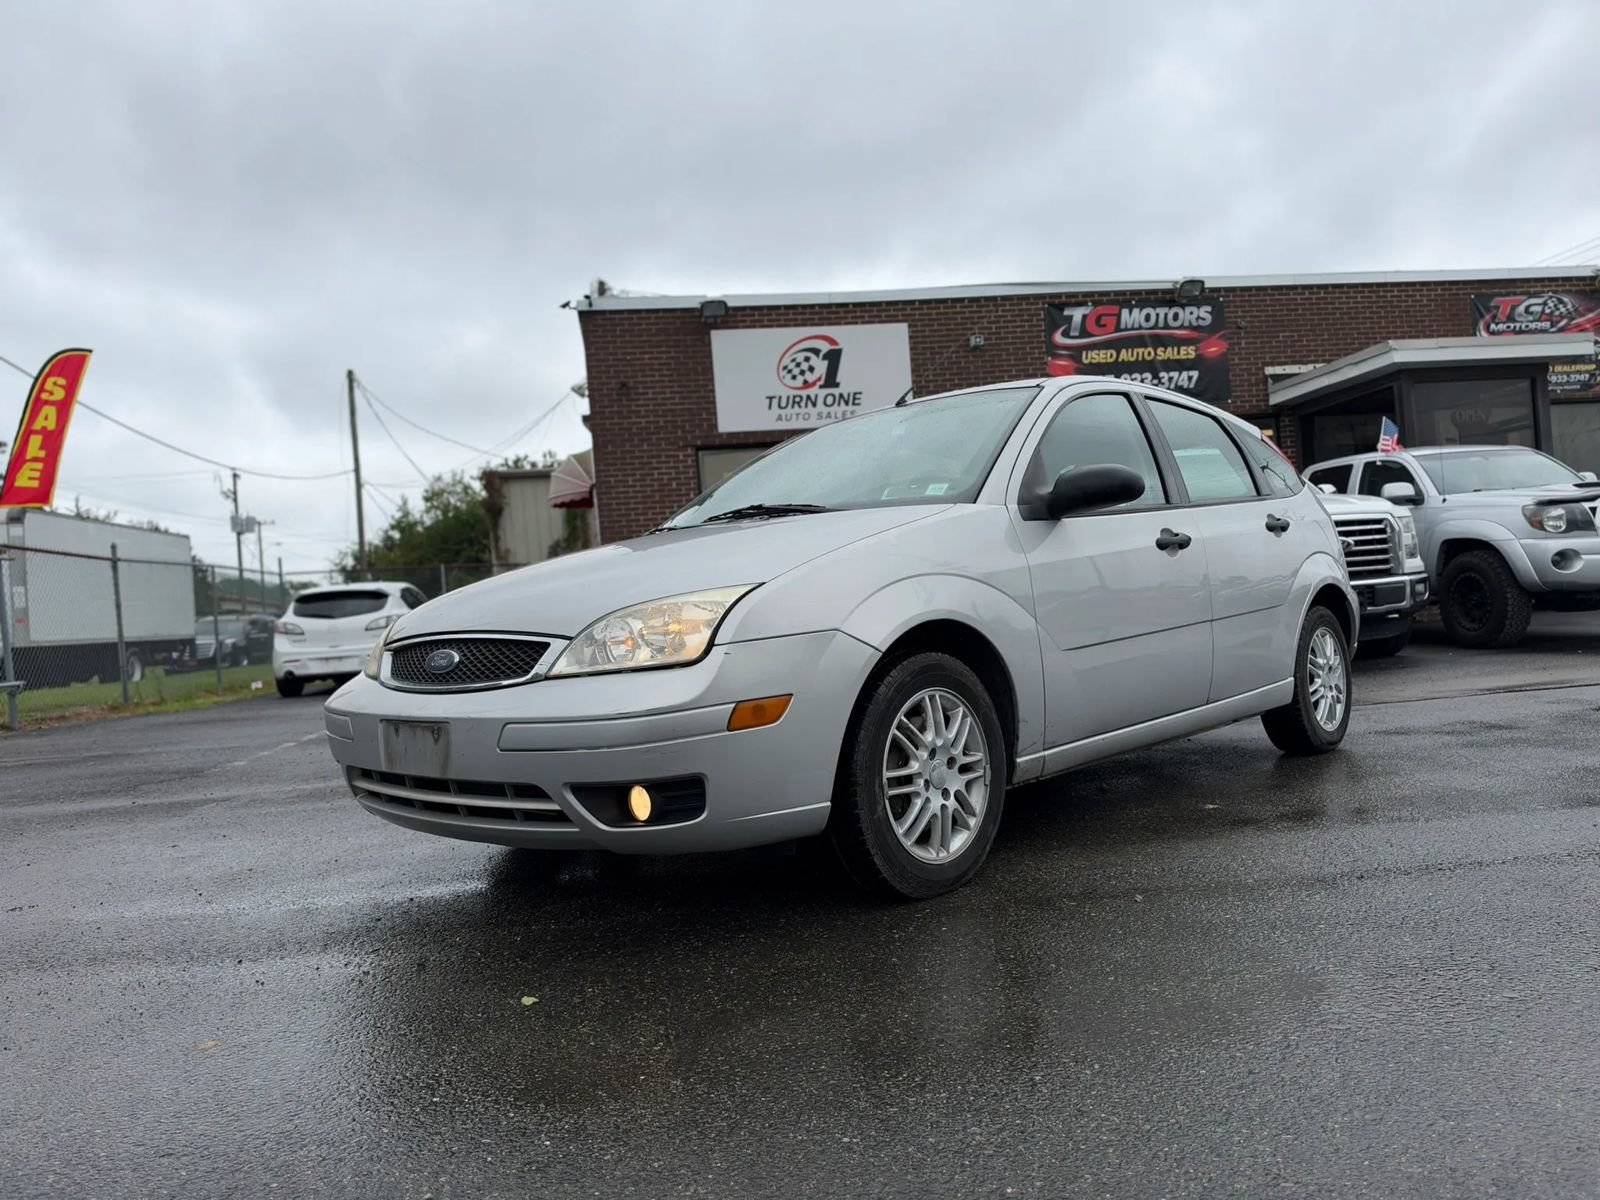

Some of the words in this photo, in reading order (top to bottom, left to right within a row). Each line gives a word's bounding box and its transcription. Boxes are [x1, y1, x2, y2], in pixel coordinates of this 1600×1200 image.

[1490, 294, 1549, 322] TG
[1063, 305, 1120, 336] TG
[1120, 305, 1212, 329] MOTORS
[1489, 321, 1551, 332] MOTORS
[1082, 348, 1117, 364] USED
[1118, 347, 1154, 362] AUTO
[1156, 346, 1196, 361] SALES
[819, 347, 844, 389] 1
[1104, 370, 1199, 389] 33-3747
[765, 394, 818, 411] TURN
[823, 391, 863, 408] ONE
[776, 411, 811, 422] AUTO
[14, 376, 67, 488] SALE
[430, 653, 449, 668] Ford
